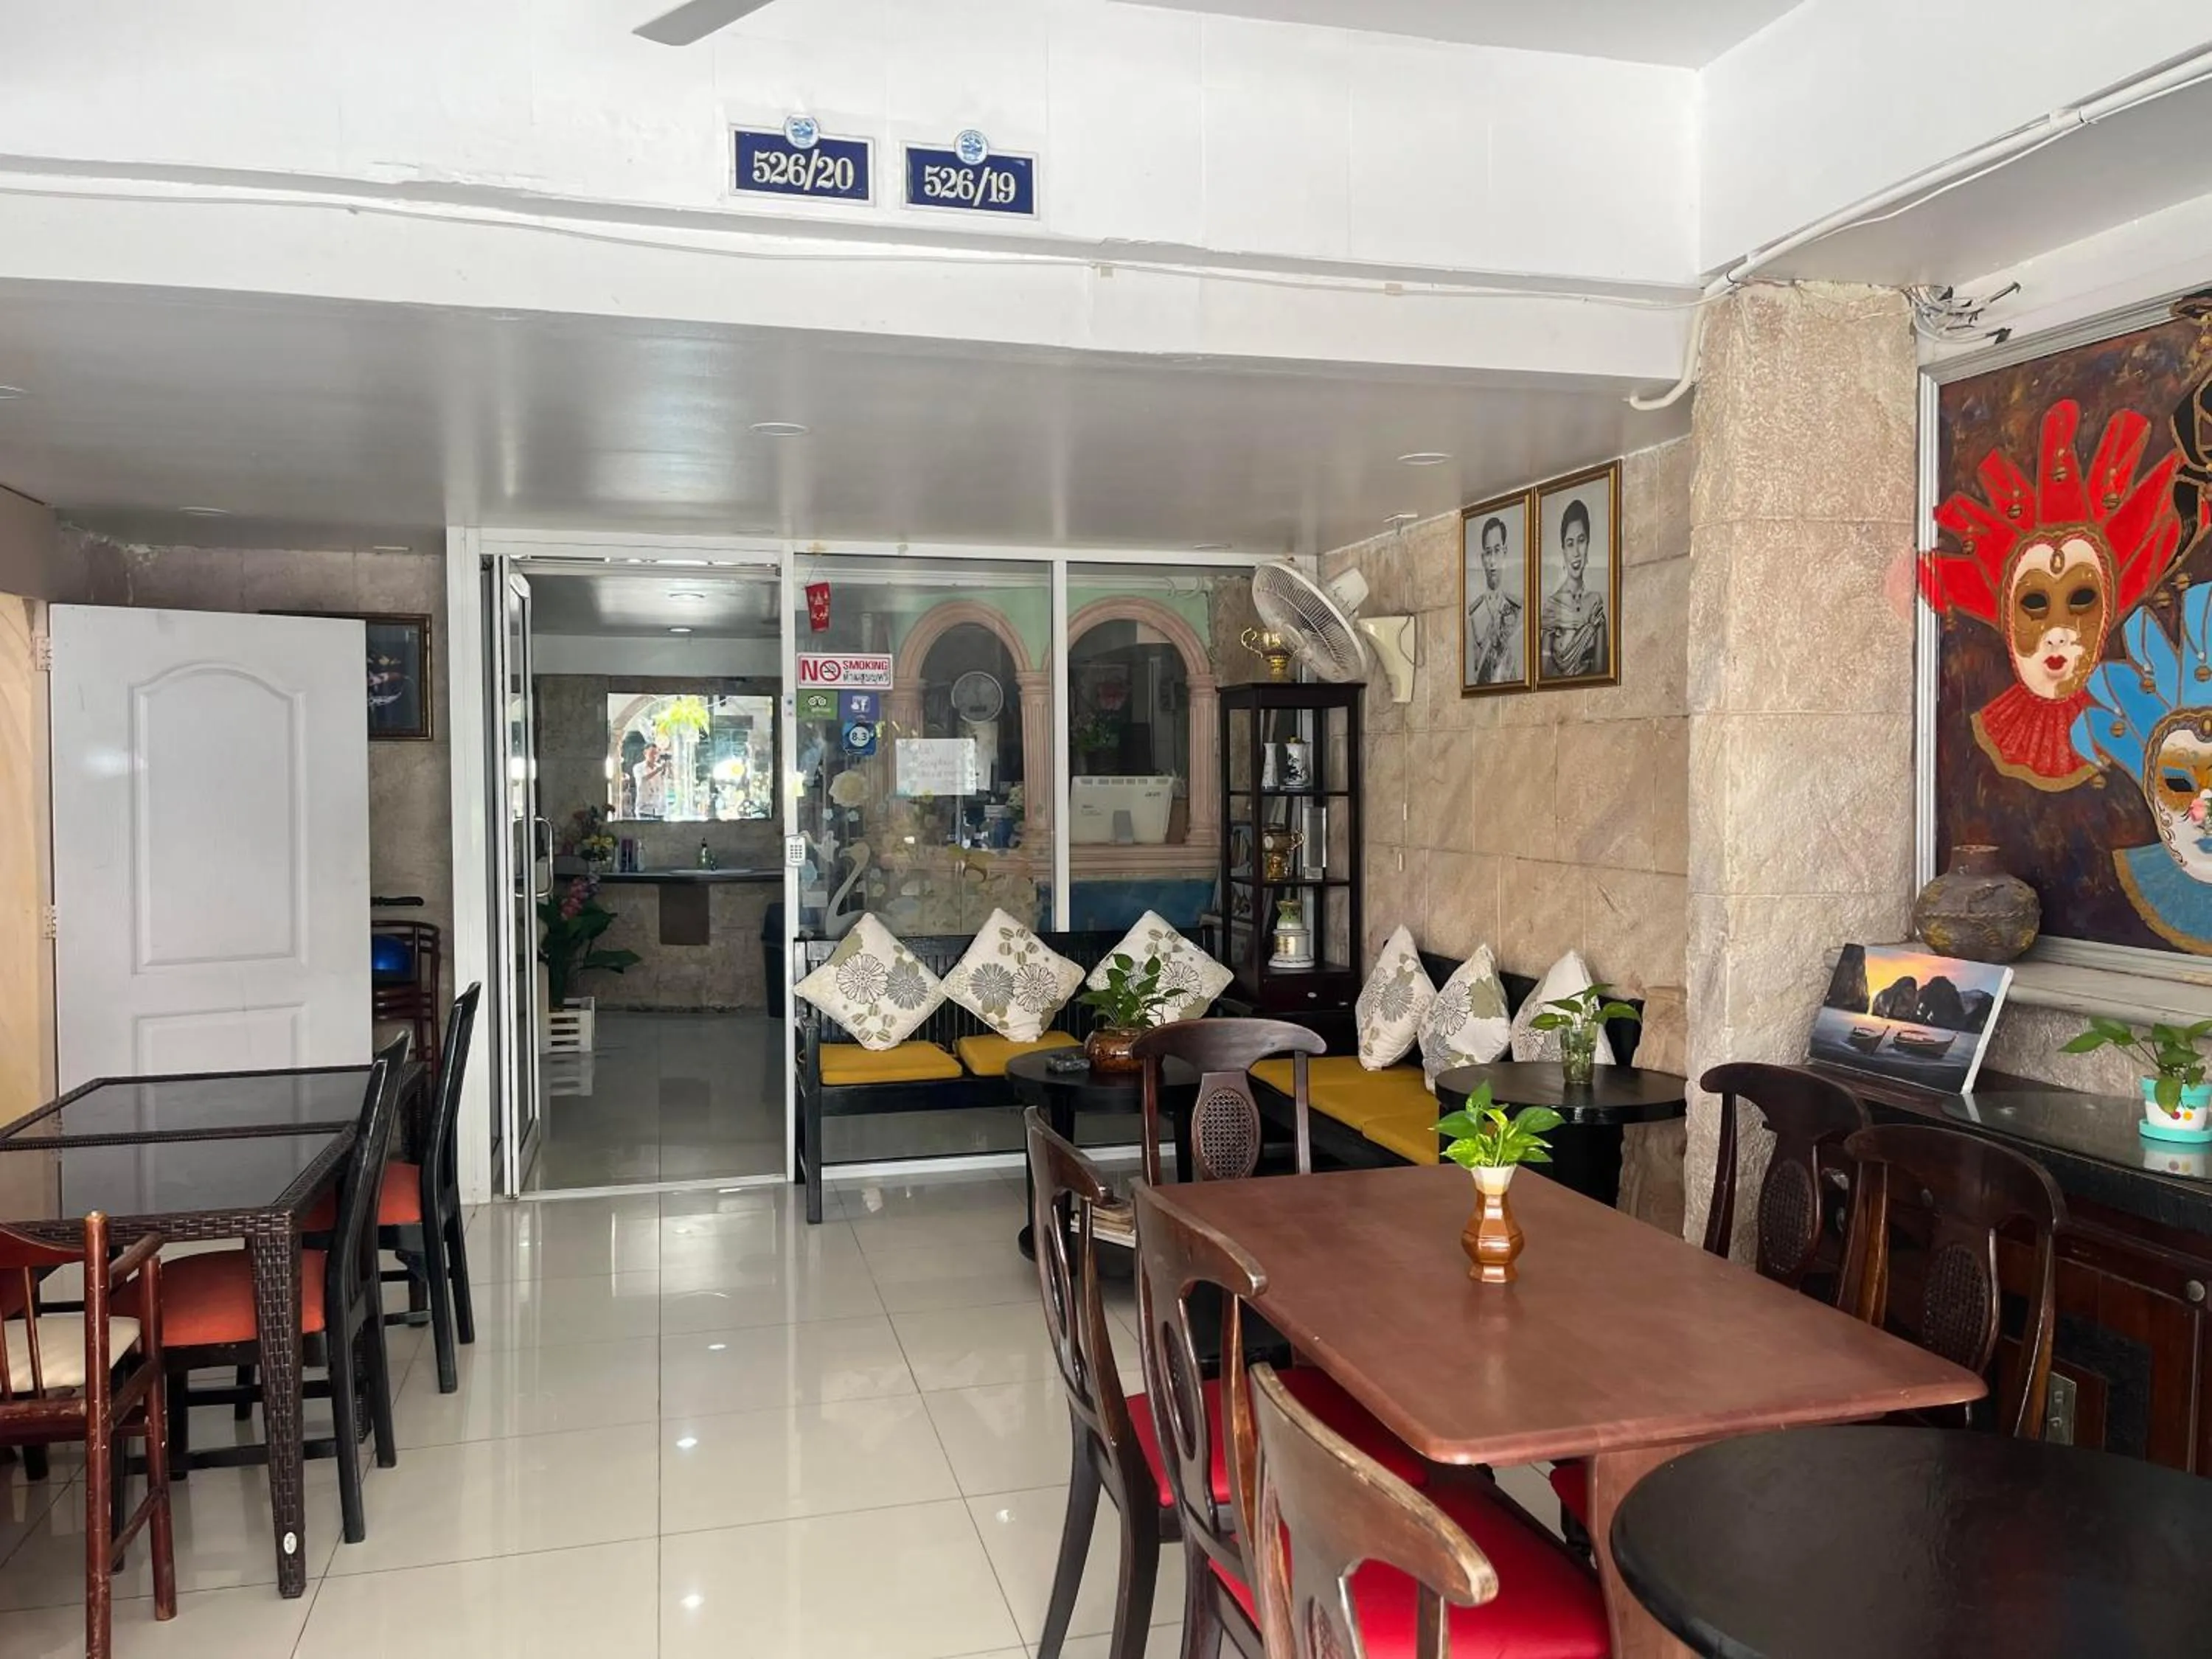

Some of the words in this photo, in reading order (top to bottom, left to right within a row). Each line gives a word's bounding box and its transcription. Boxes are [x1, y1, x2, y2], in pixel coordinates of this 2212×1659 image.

[752, 148, 855, 191] 526/20
[924, 165, 1016, 206] 526/19
[843, 660, 888, 670] SMOKING
[852, 732, 867, 741] 8.3
